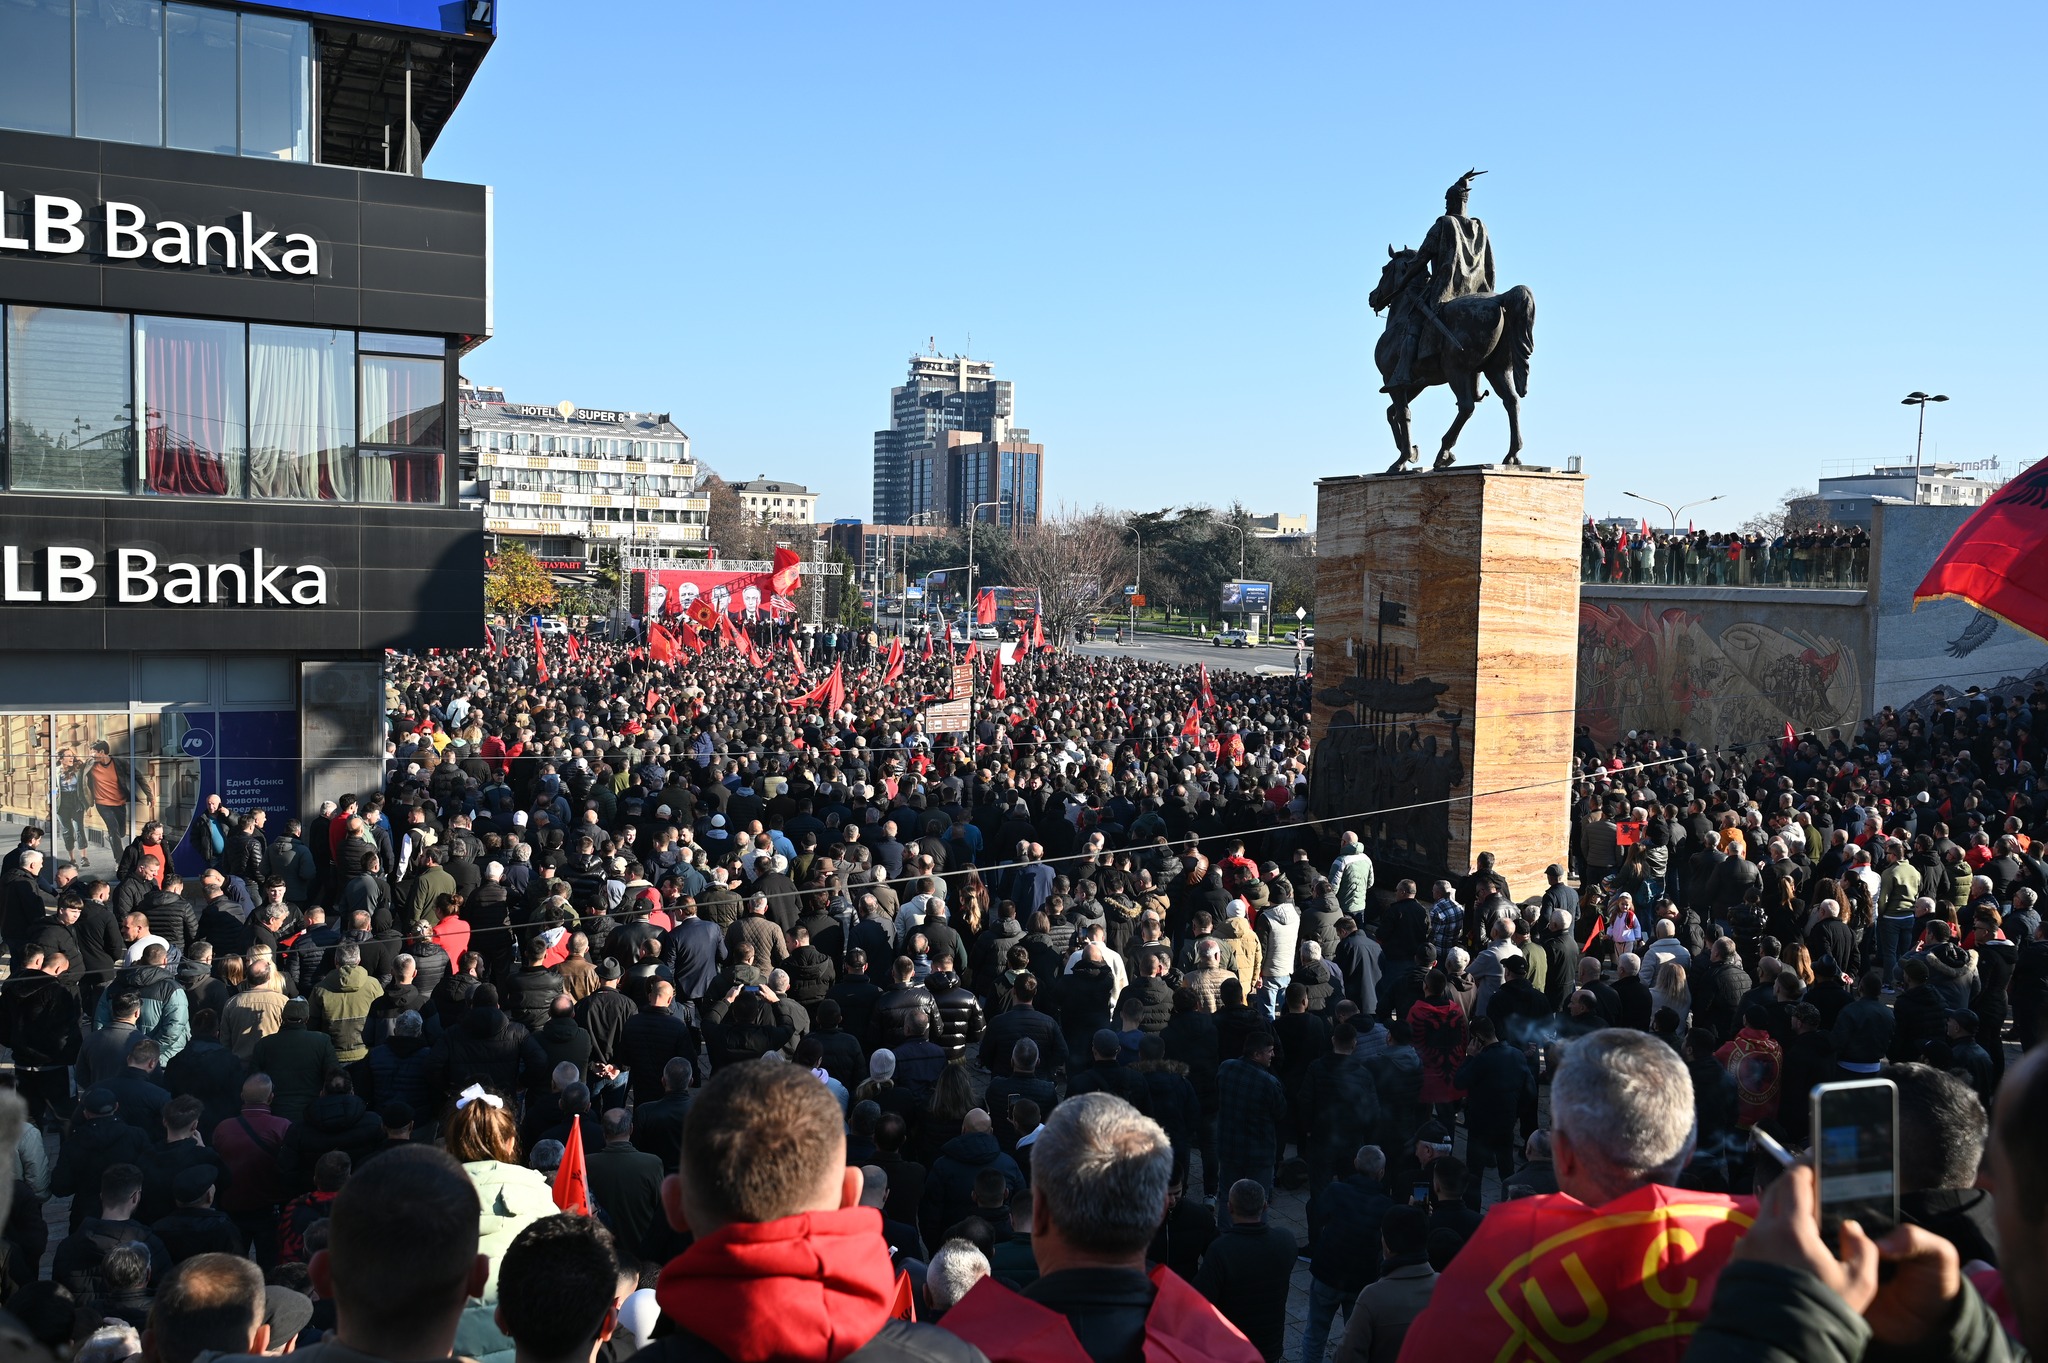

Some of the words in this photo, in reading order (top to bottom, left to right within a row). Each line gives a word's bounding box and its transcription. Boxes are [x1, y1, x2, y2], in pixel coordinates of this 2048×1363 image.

[106, 201, 319, 275] Banka
[522, 406, 555, 417] HOTEL
[578, 410, 615, 421] SUPER
[618, 413, 624, 422] 8
[536, 561, 581, 569] СТАУРАНТ
[118, 547, 327, 604] Banka
[531, 616, 538, 626] P
[226, 779, 251, 787] Една
[253, 778, 284, 786] банка
[1519, 1228, 1743, 1344] UÇ
